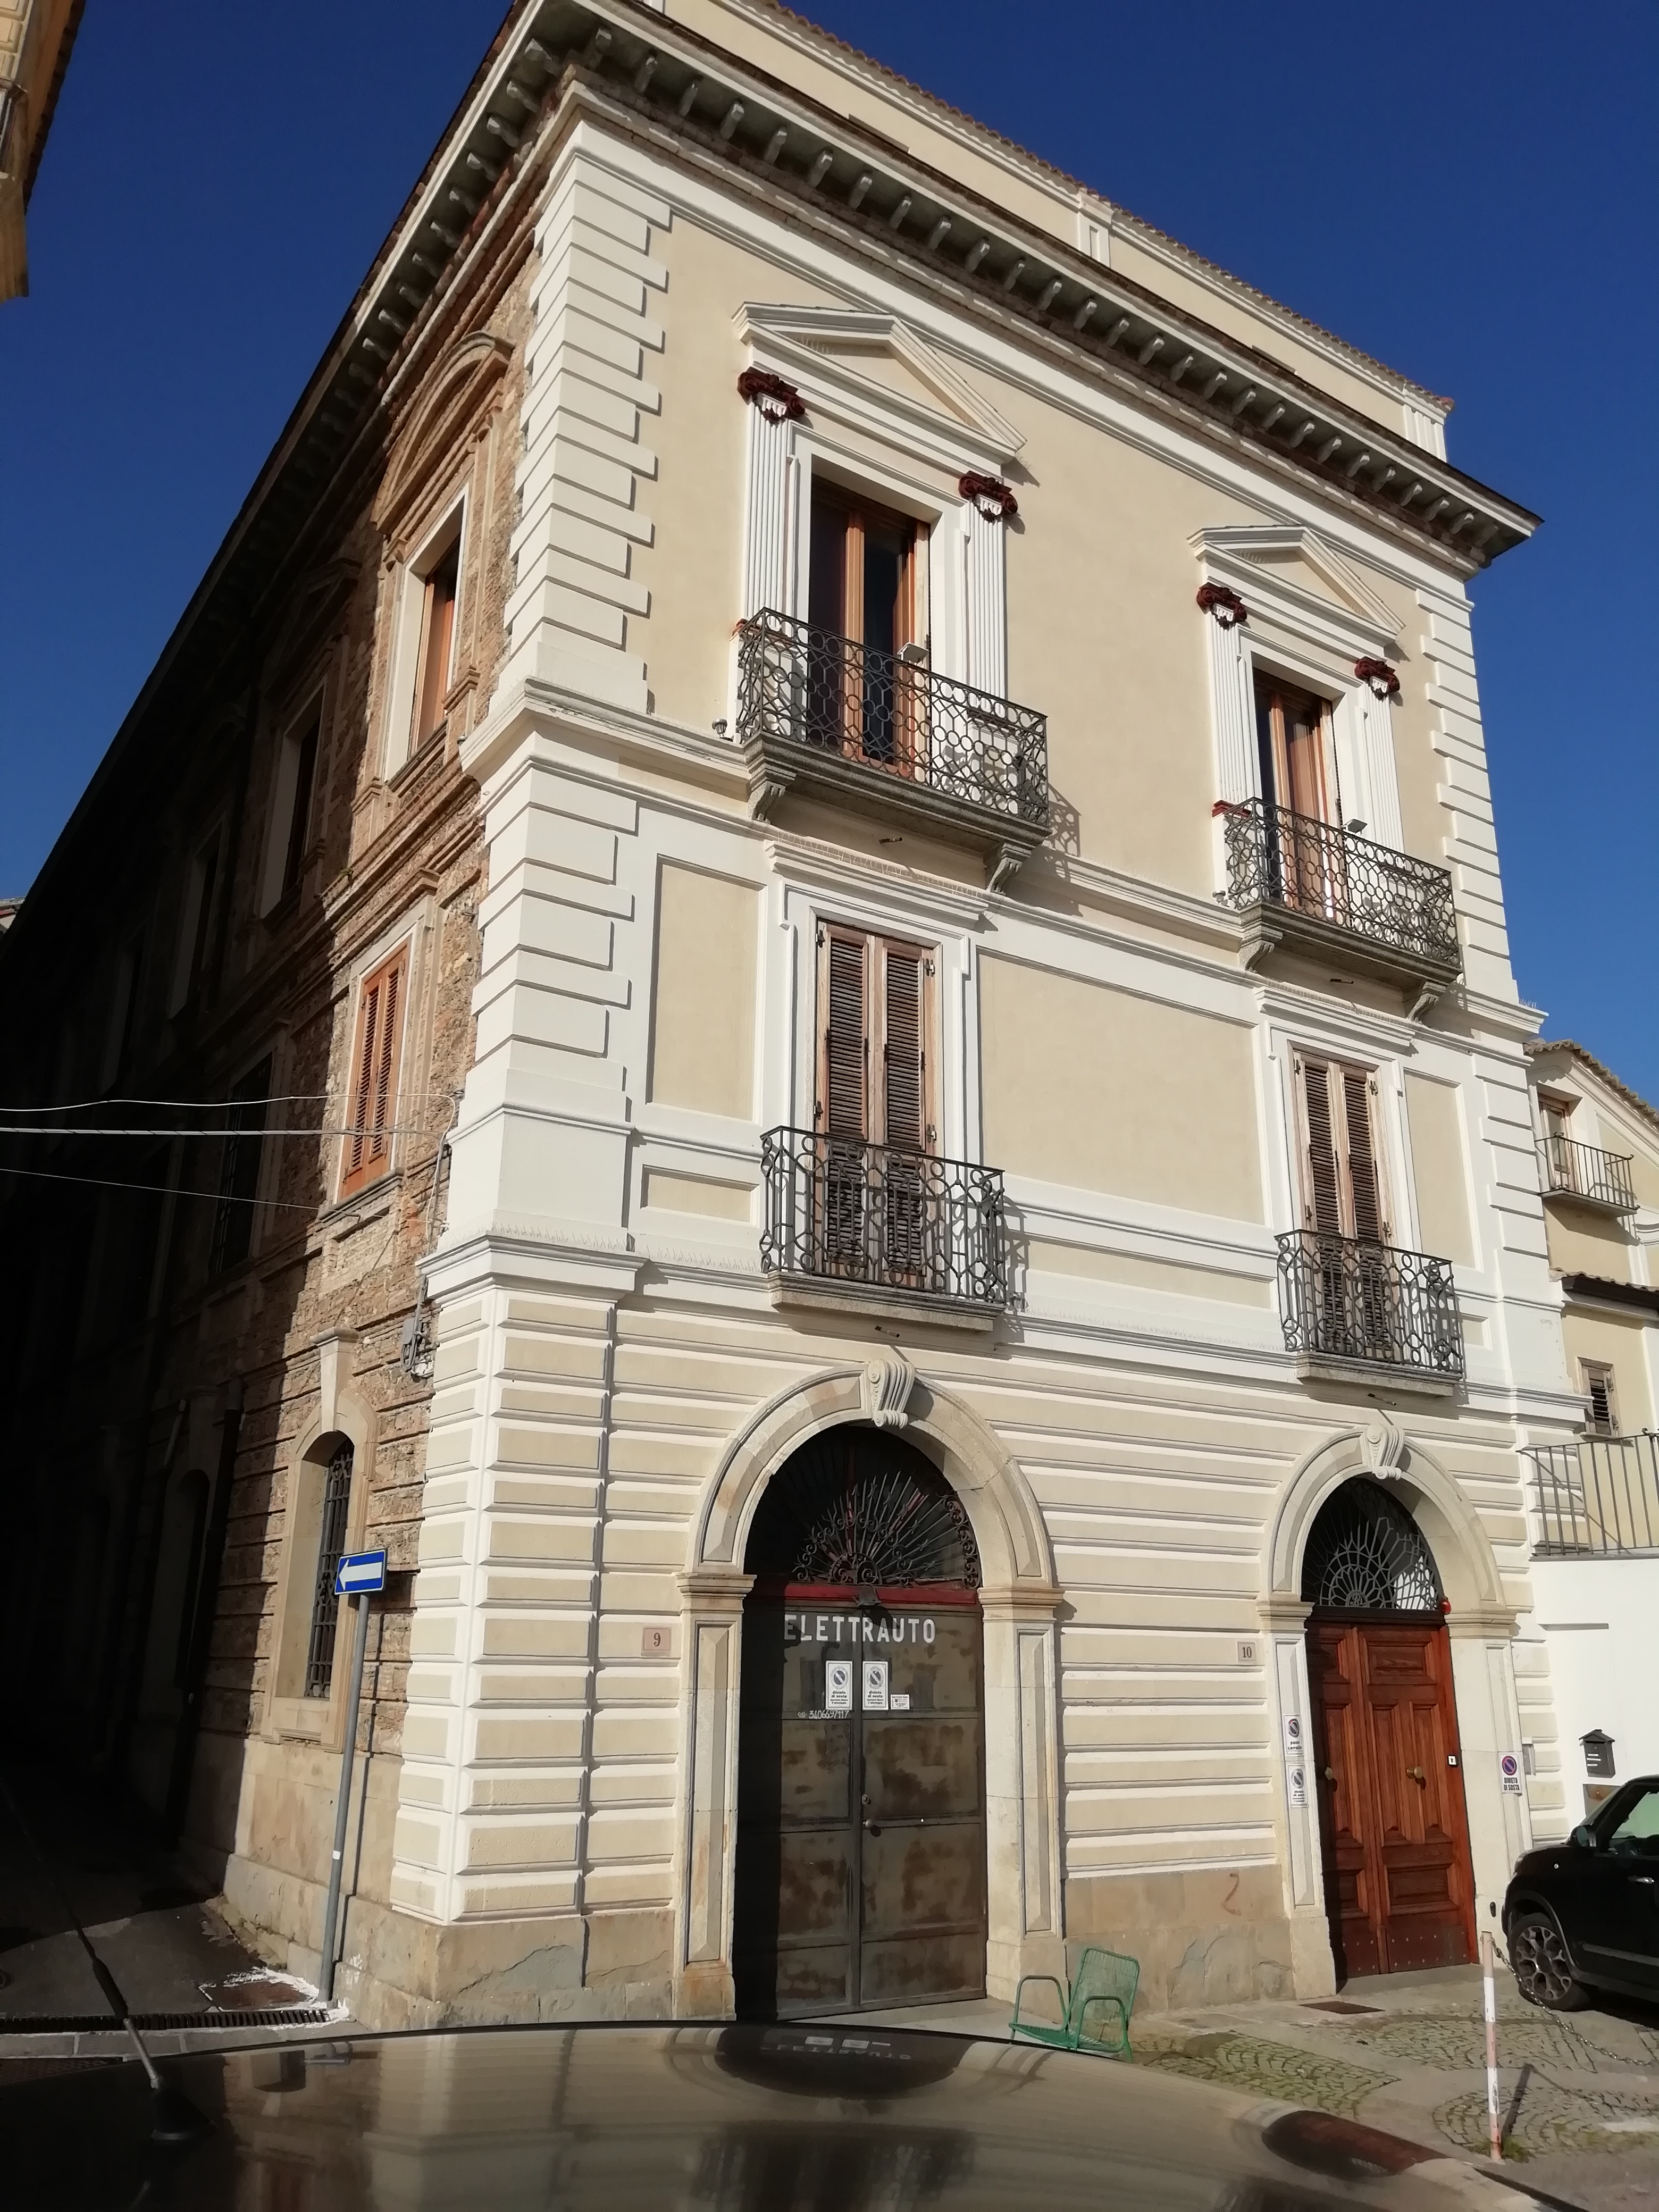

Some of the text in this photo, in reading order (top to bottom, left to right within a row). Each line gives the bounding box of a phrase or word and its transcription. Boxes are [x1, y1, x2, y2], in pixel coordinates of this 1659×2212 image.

[784, 1613, 936, 1643] ELETTRAUTO
[653, 1632, 661, 1647] 9
[1242, 1646, 1252, 1658] 10
[809, 1710, 849, 1719] 3406697117
